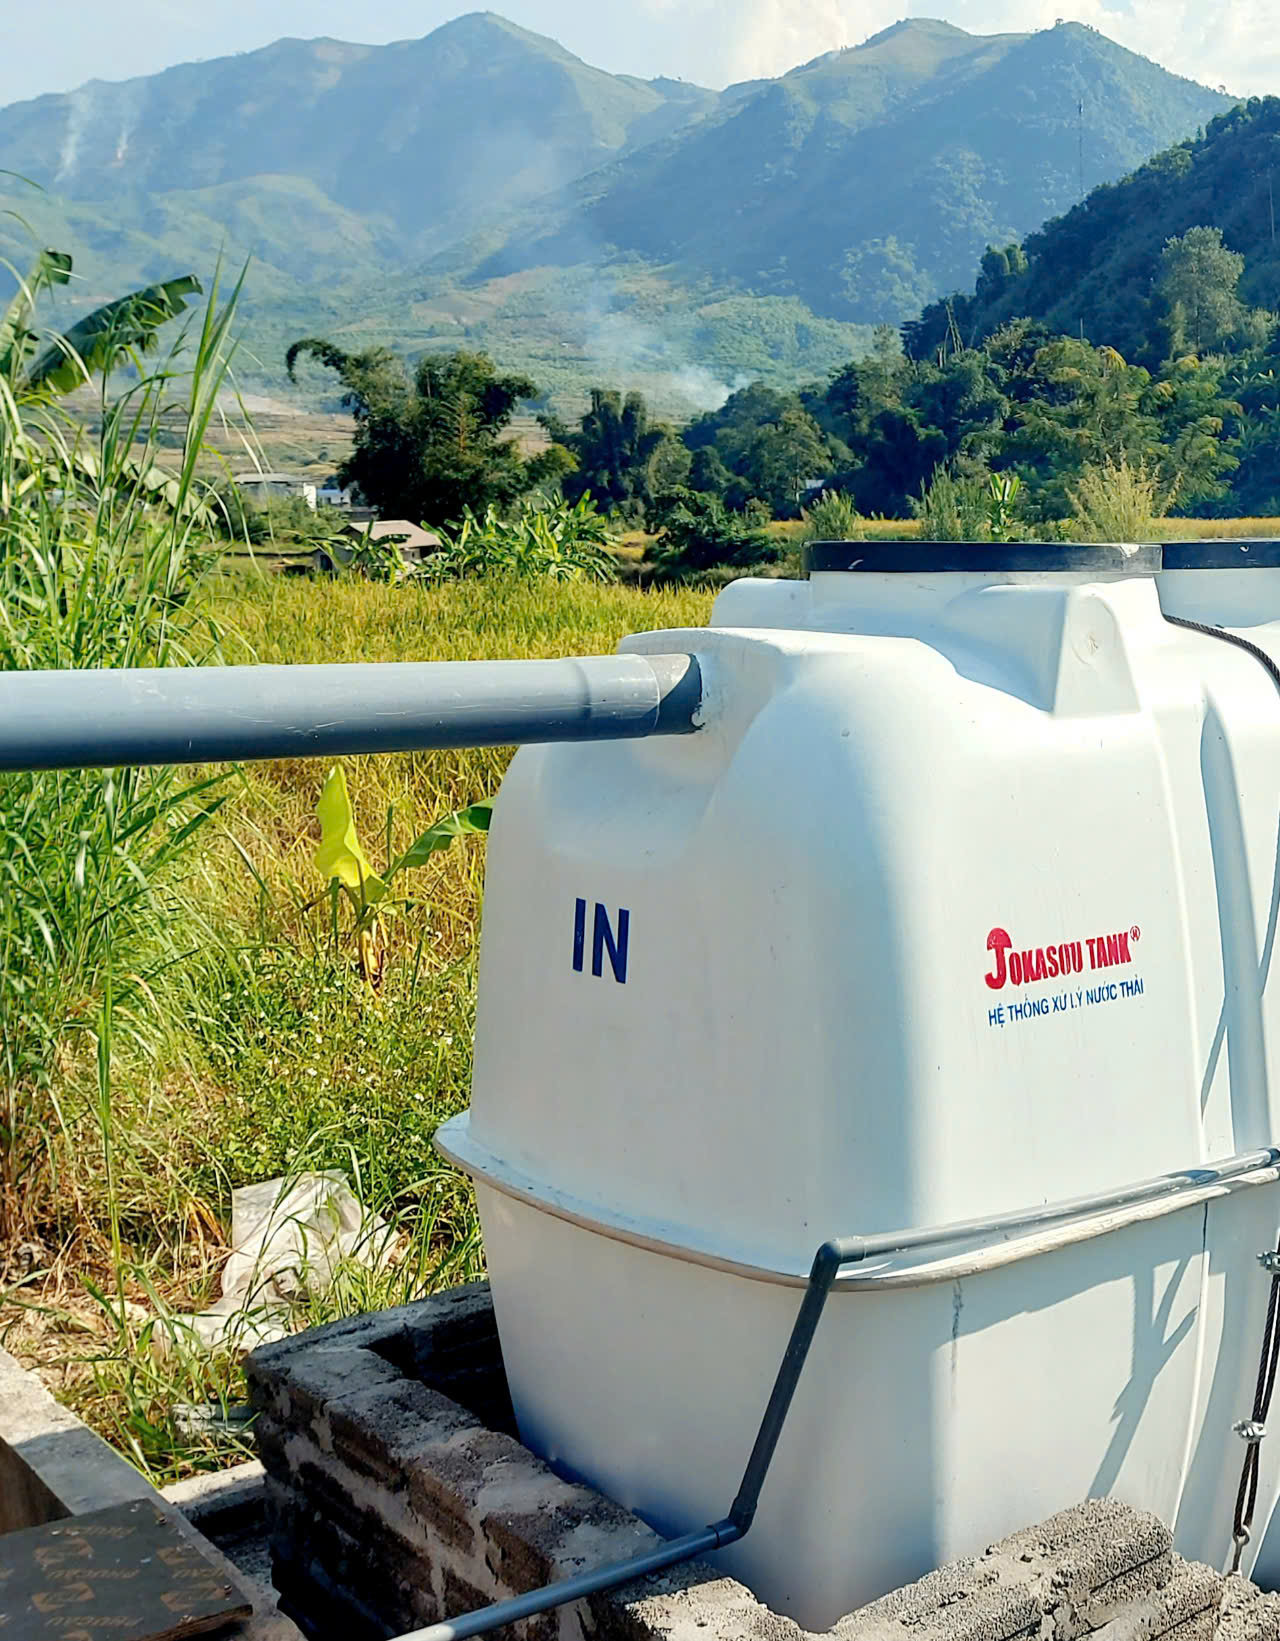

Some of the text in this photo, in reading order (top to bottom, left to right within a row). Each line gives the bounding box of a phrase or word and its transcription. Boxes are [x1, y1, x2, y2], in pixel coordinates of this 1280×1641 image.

[572, 897, 630, 985] IN
[984, 928, 1084, 990] JOKASOU
[988, 1002, 1006, 1028] HỆ
